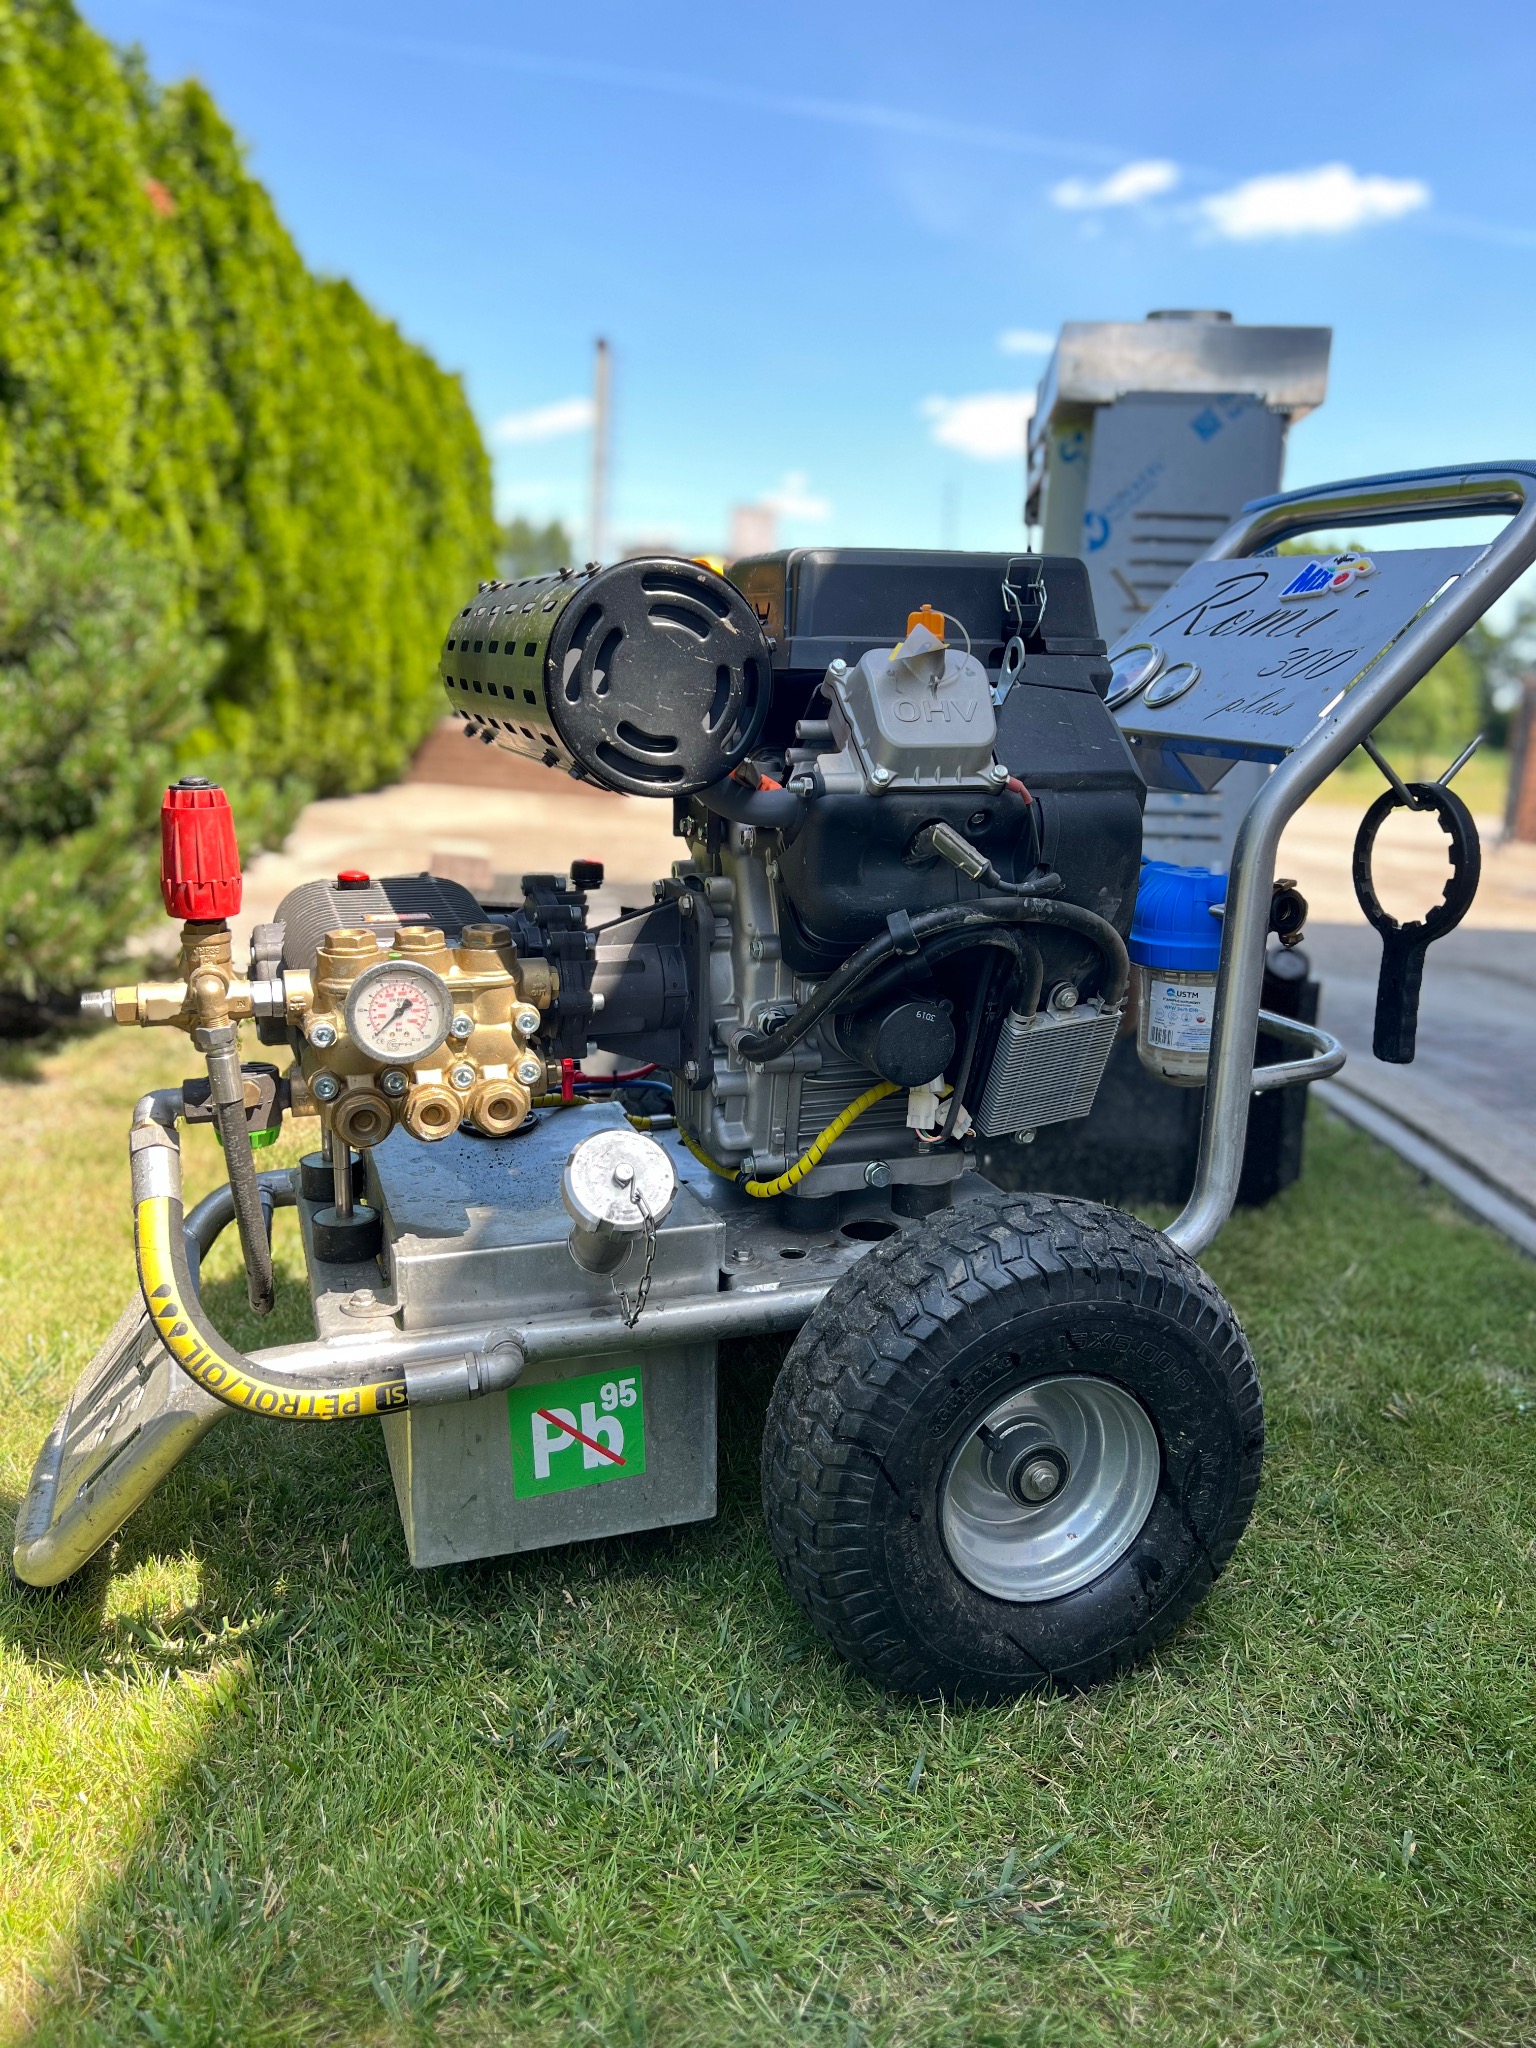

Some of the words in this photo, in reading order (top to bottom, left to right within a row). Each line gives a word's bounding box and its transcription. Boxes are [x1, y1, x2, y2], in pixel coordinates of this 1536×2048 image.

[1257, 647, 1364, 680] 300
[893, 698, 979, 723] OHV
[1203, 687, 1295, 721] plus
[1176, 990, 1199, 999] USTM
[915, 1010, 936, 1023] 3019
[184, 1338, 361, 1417] PETROL/OIL
[531, 1401, 625, 1480] Pb
[600, 1378, 637, 1411] 95
